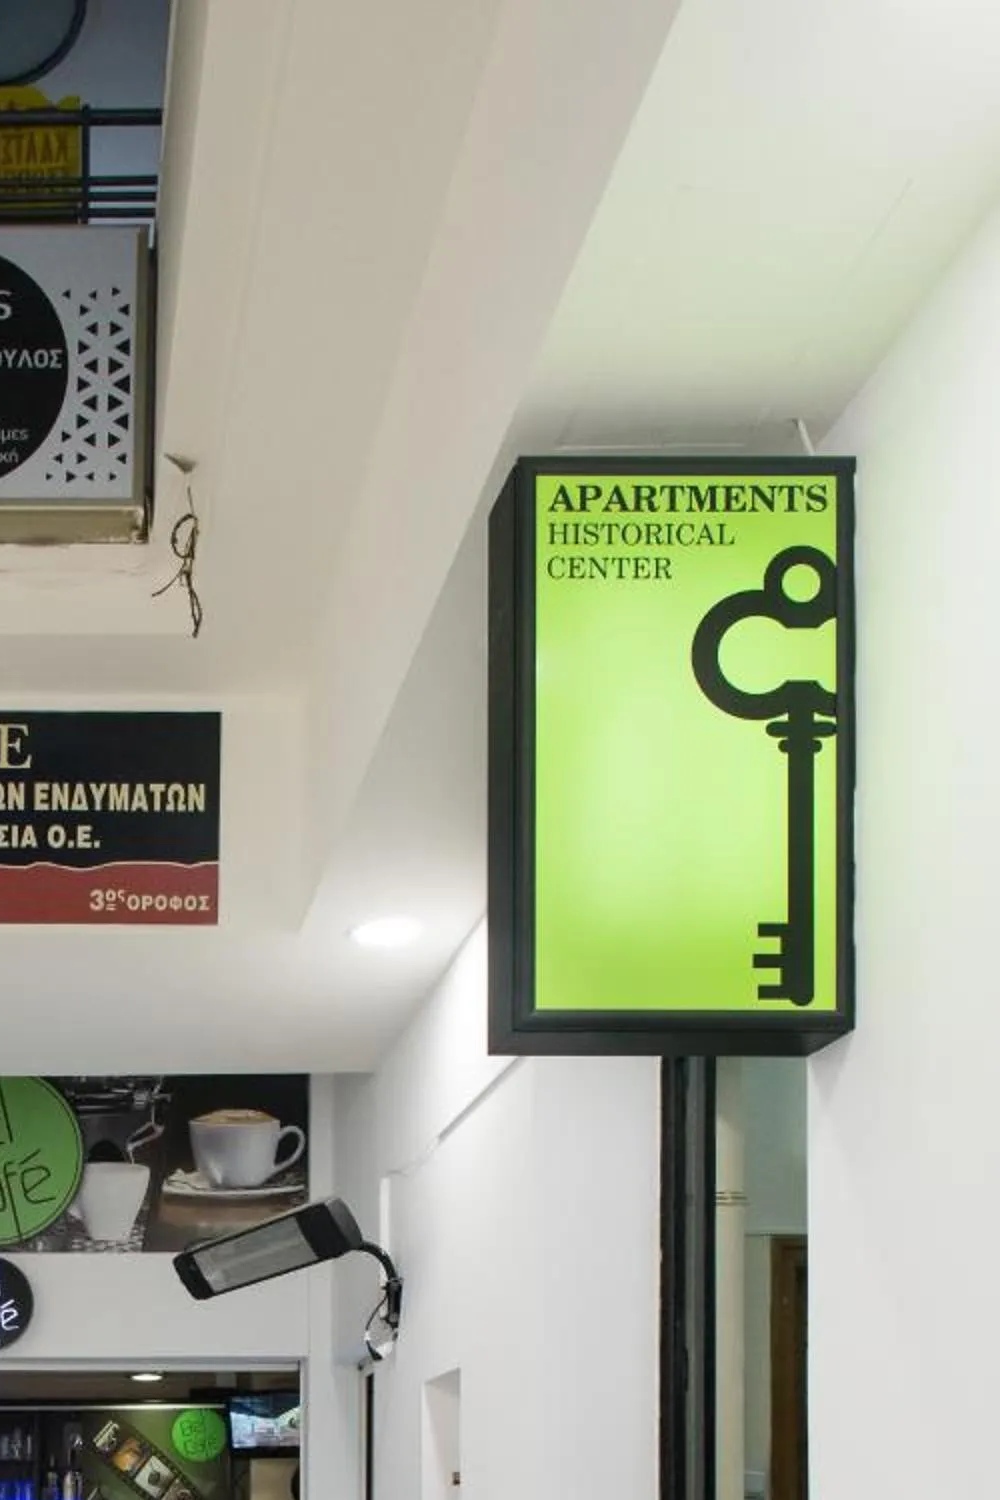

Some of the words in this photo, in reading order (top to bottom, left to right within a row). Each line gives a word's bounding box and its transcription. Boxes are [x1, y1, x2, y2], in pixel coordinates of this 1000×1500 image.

[547, 483, 829, 513] APARTMENTS
[547, 522, 736, 547] HISTORICAL
[546, 556, 673, 580] CENTER
[34, 782, 206, 812] ΕΝΔΥΜΑΤΩΝ
